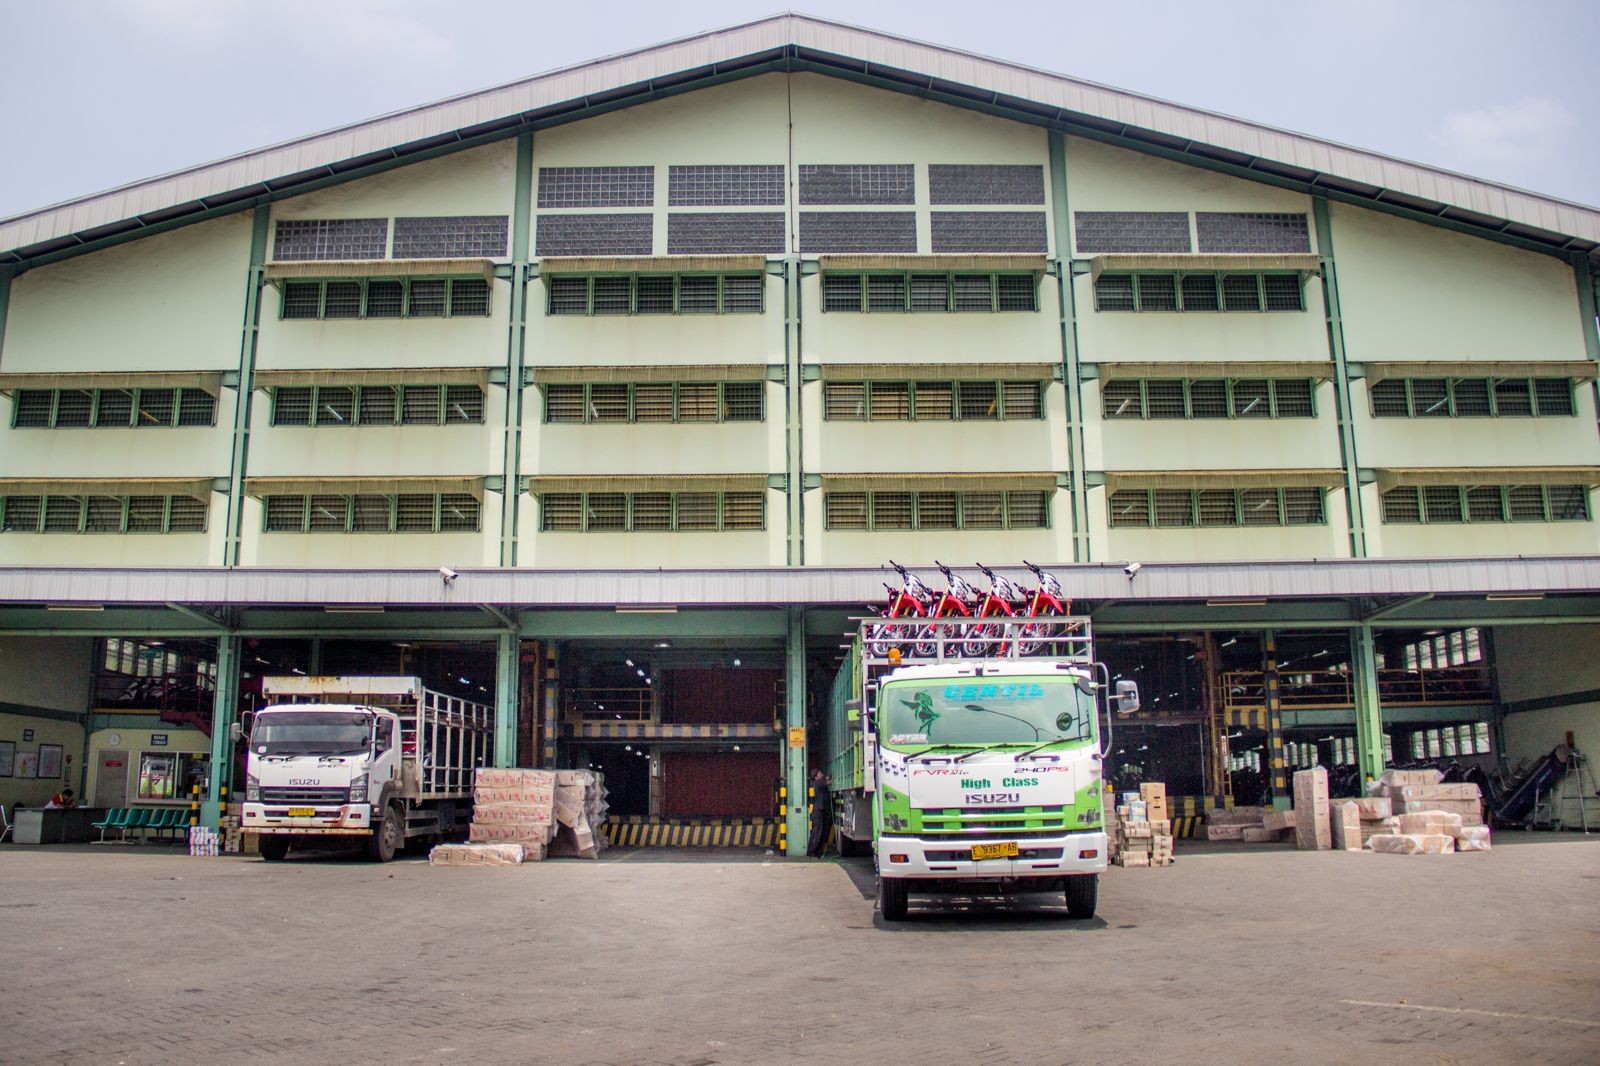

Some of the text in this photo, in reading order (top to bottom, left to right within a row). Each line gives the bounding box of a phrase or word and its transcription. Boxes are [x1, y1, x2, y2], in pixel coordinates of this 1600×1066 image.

[961, 776, 1039, 789] High Class
[965, 793, 1020, 804] ISUZU
